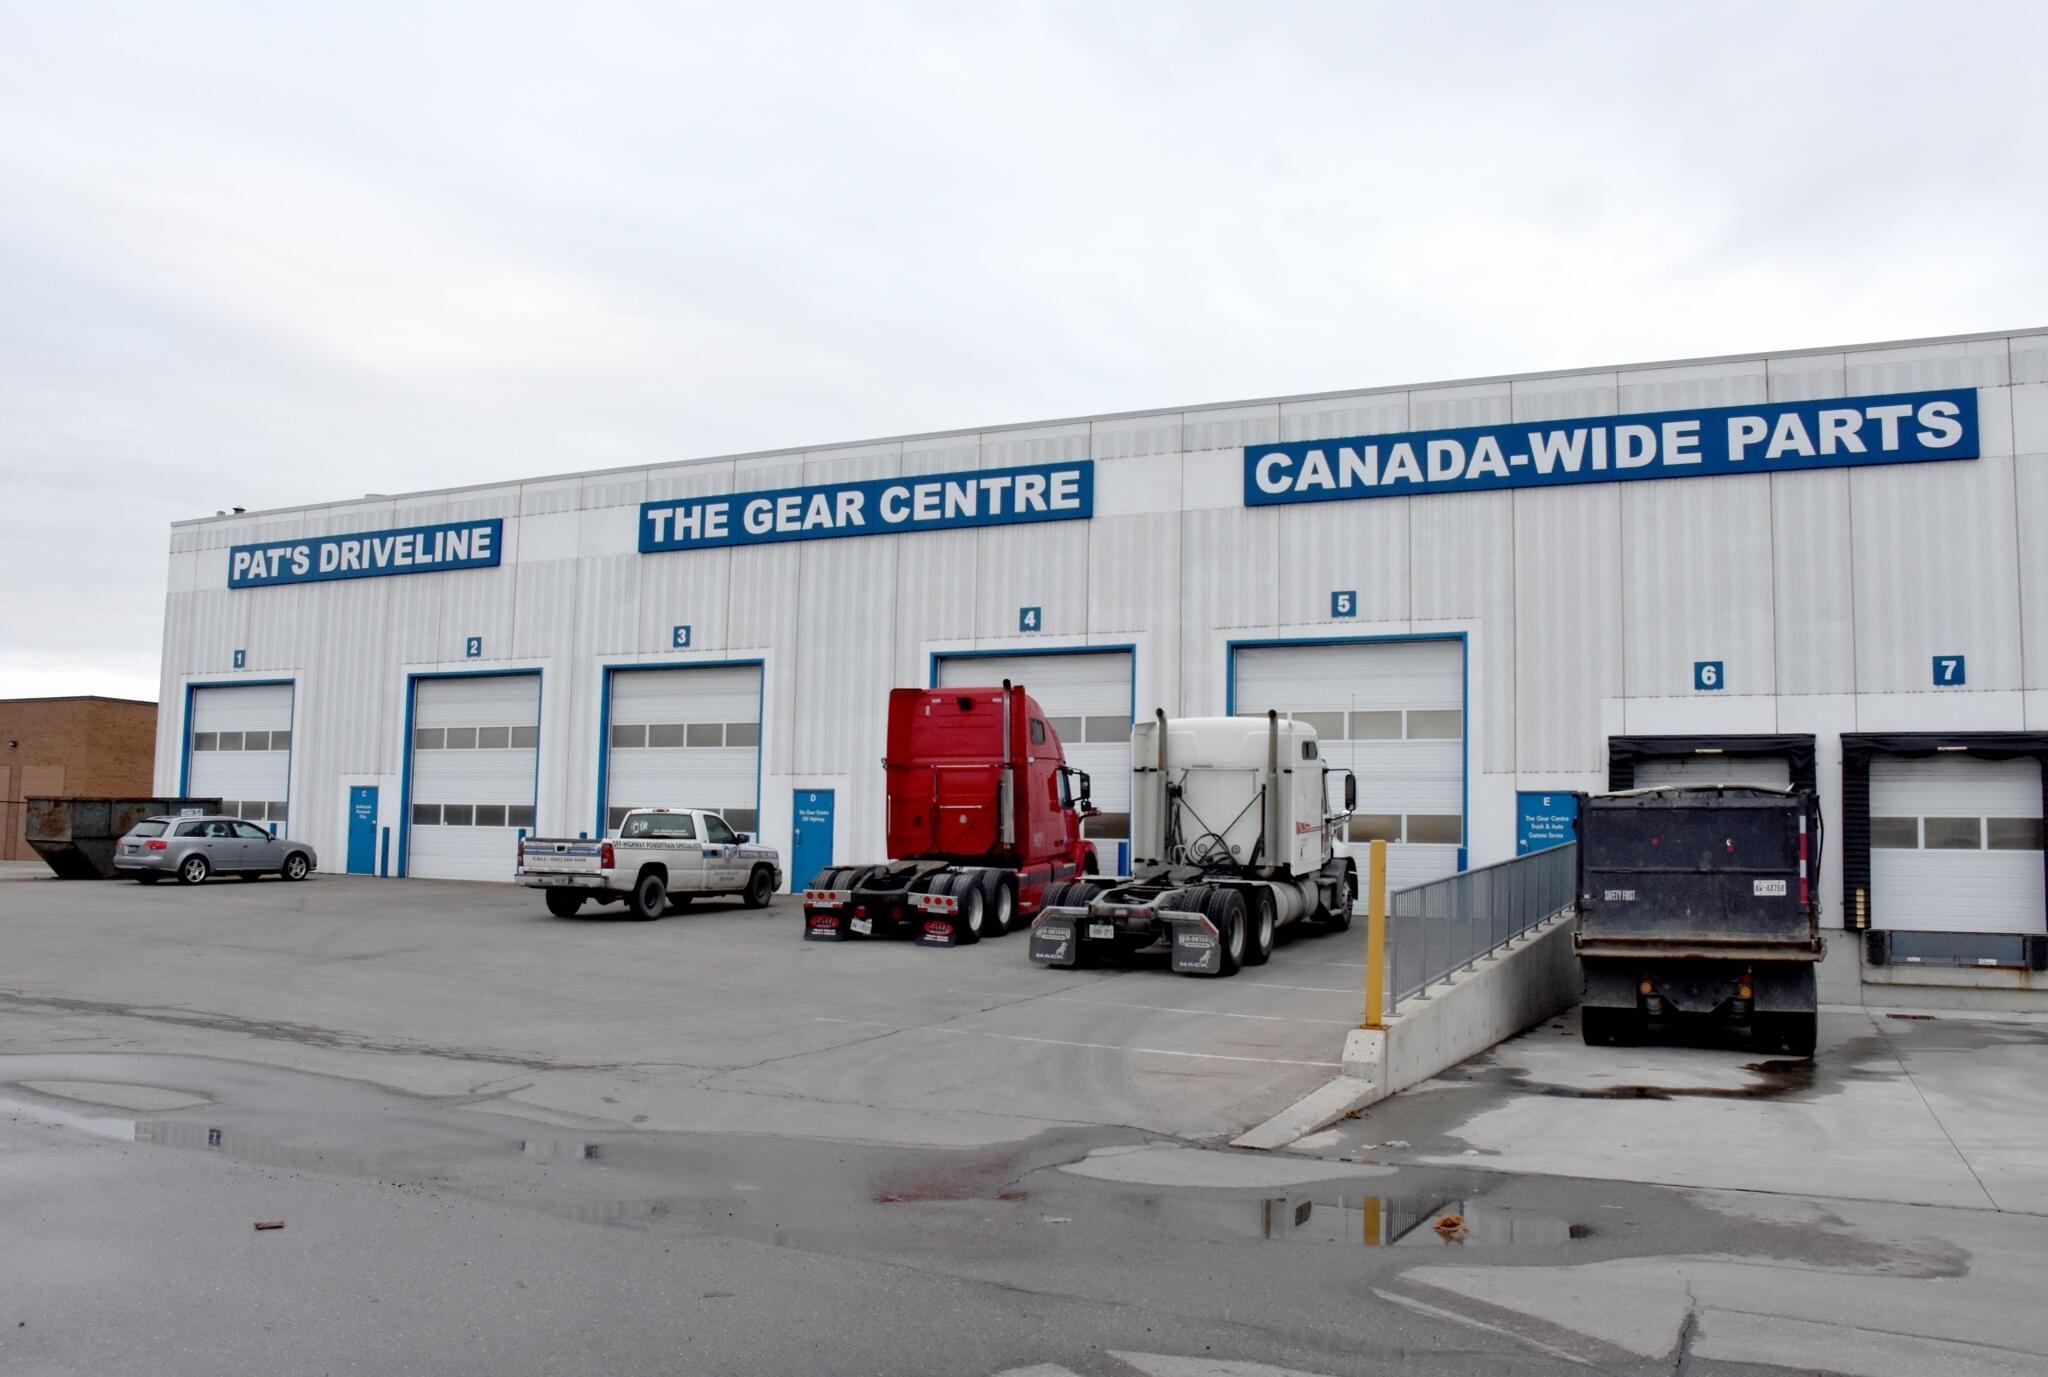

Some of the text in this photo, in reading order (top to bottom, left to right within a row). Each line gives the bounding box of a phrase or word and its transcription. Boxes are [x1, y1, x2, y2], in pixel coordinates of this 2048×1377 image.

[1255, 401, 1963, 494] CANADA-WIDE PARTS
[647, 470, 1080, 543] THE GEAR CENTRE
[233, 527, 492, 580] PAT'S DRIVELINE
[1337, 594, 1350, 613] 5
[1024, 610, 1036, 627] 4
[677, 628, 687, 644] 3
[470, 640, 478, 654] 2
[1701, 665, 1717, 685] 6
[1941, 660, 1957, 680] 7
[810, 794, 817, 802] D
[1543, 797, 1551, 806] E
[1604, 890, 1636, 901] SAFETY FIRST
